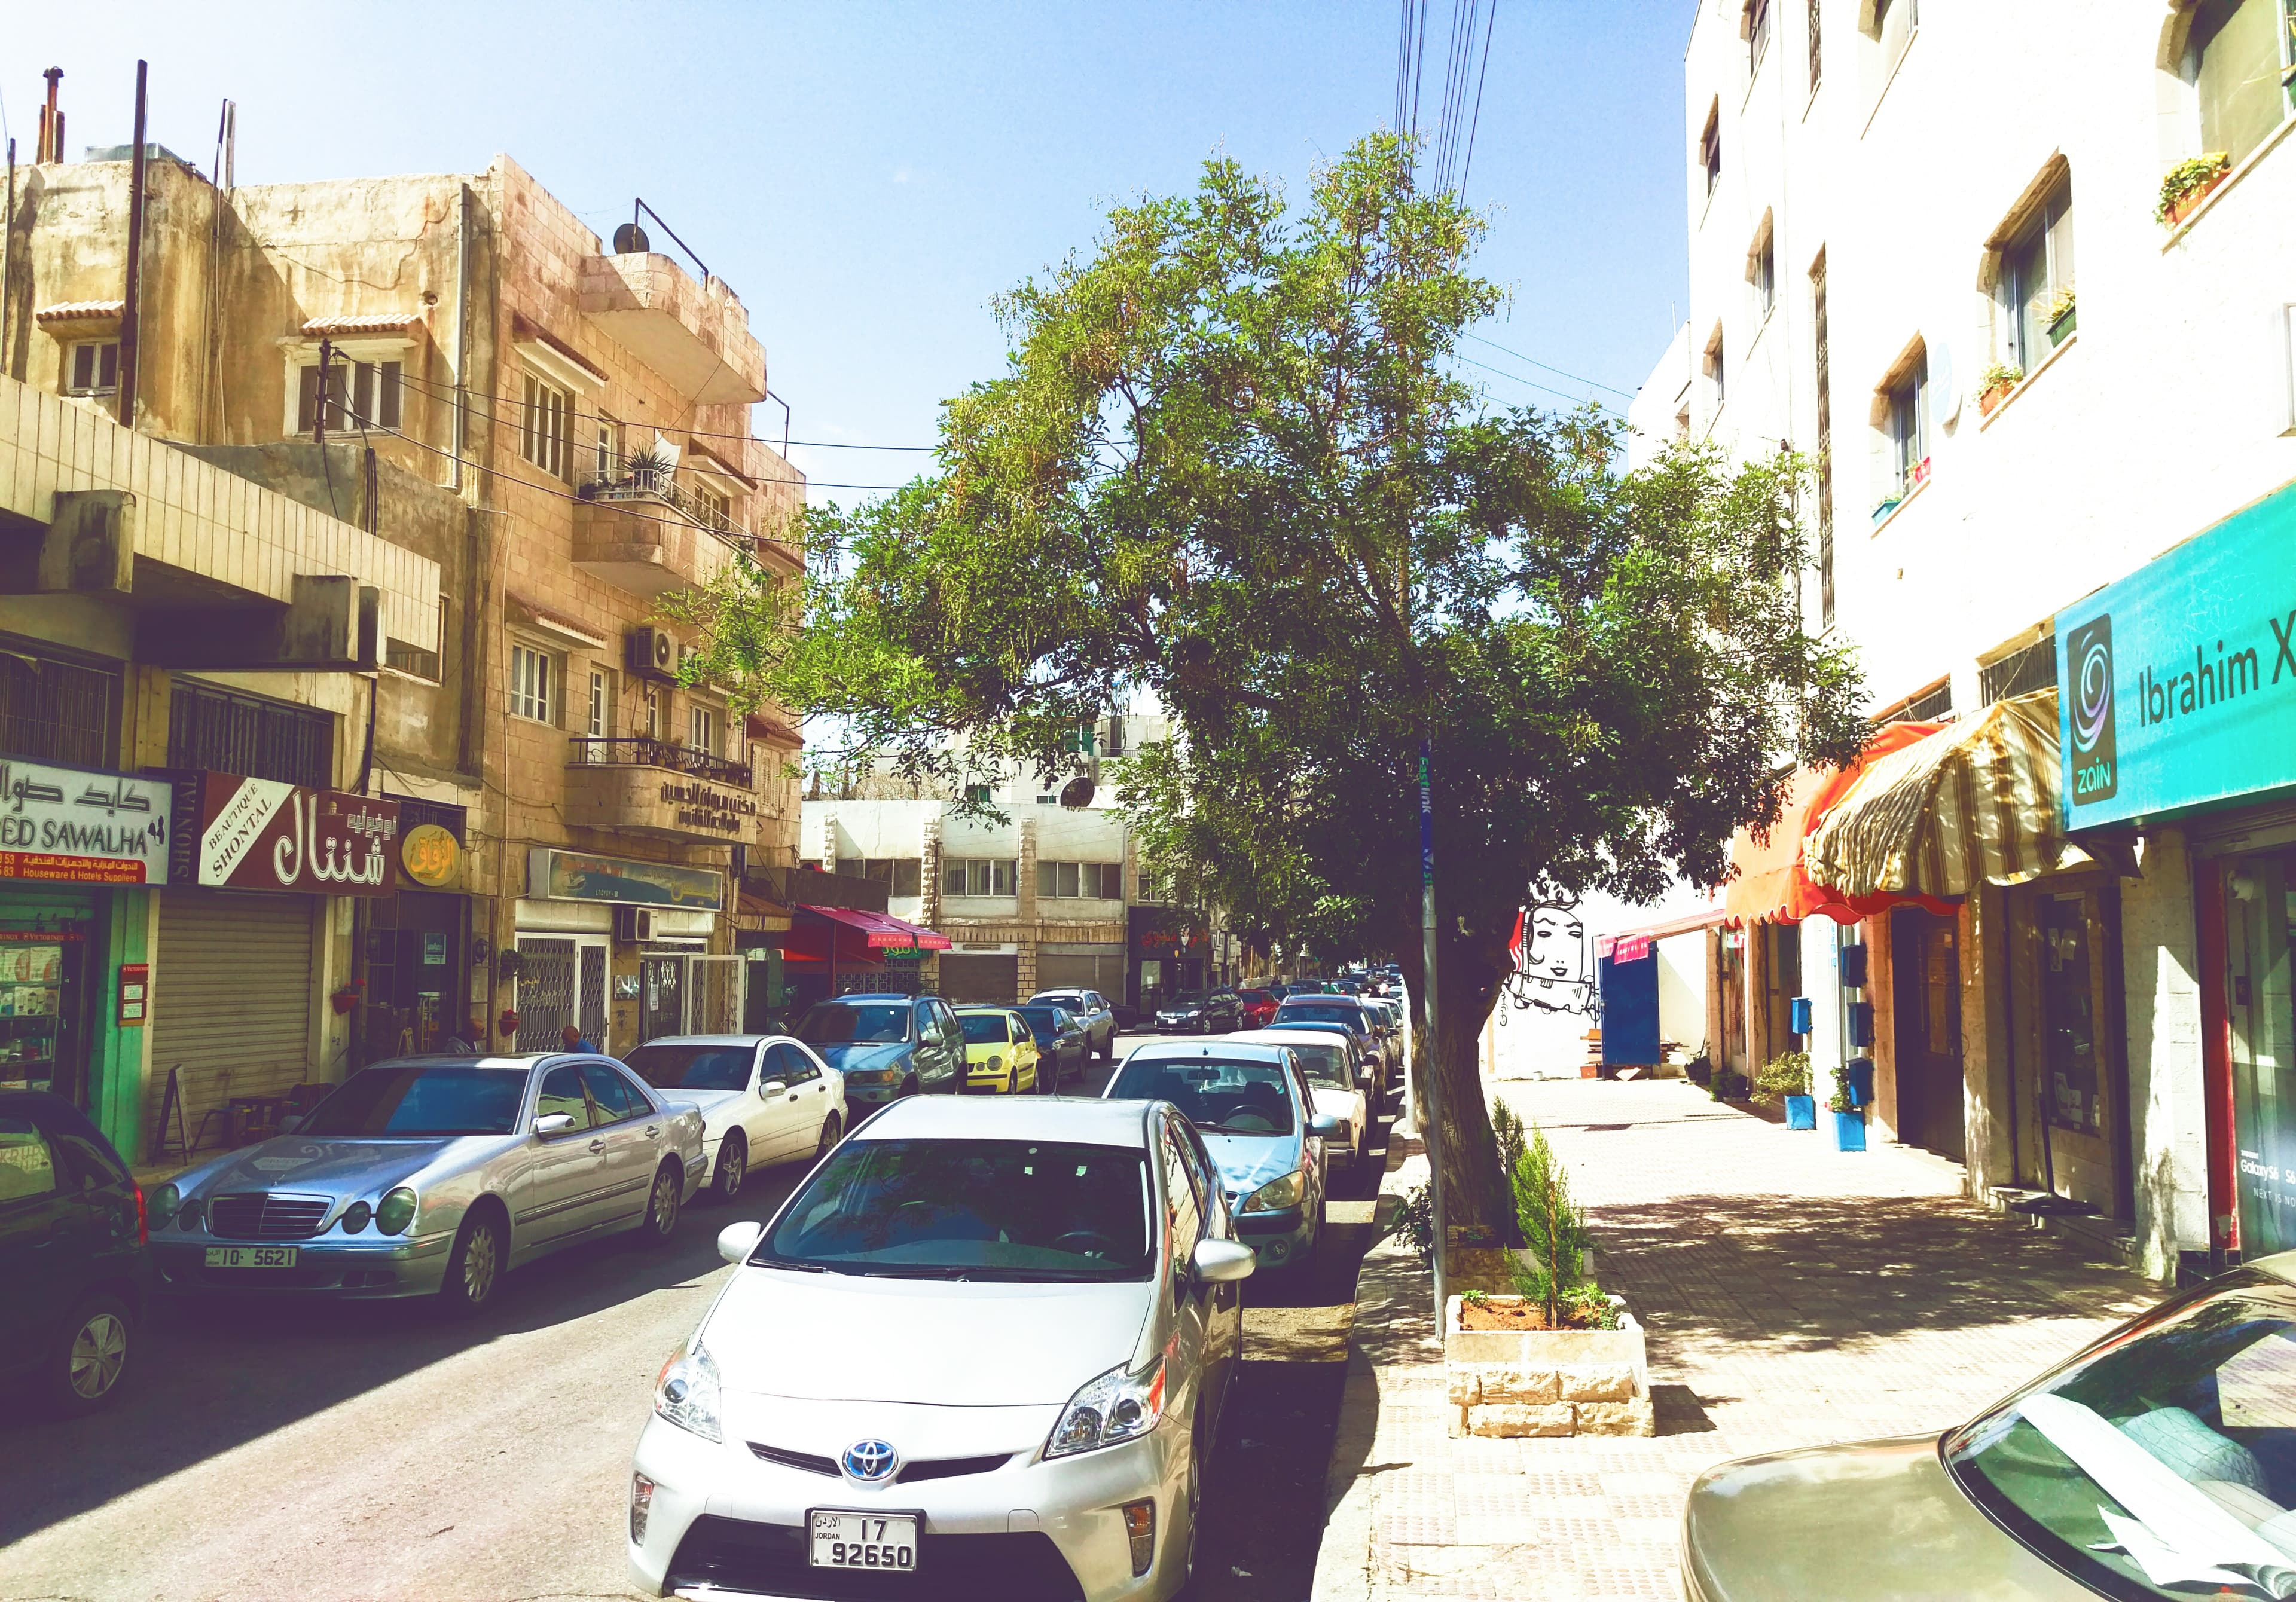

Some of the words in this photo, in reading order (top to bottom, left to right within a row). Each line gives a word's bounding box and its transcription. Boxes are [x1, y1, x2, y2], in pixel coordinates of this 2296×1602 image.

[2139, 640, 2259, 727] Ibrahim
[74, 777, 151, 815] كايد
[1419, 757, 1432, 814] Fastlink
[172, 775, 198, 878] SHONTAL
[209, 784, 258, 850] BEAUTIQUE
[42, 820, 148, 857] SAWALHA
[213, 799, 272, 878] SHONTAL
[274, 790, 385, 885] شنتال
[23, 867, 68, 880] Houseware
[71, 870, 75, 879] &
[78, 871, 102, 881] Hotels
[103, 872, 137, 883] Suppliers
[2240, 1159, 2268, 1181] Galaxy
[2268, 1166, 2279, 1180] S6
[2285, 1169, 2296, 1185] S6
[2253, 1187, 2271, 1200] NEXT
[2274, 1193, 2282, 1203] IS
[223, 1249, 239, 1265] 10
[254, 1249, 292, 1265] 5621
[862, 1519, 887, 1540] 17
[832, 1542, 911, 1567] 92650
